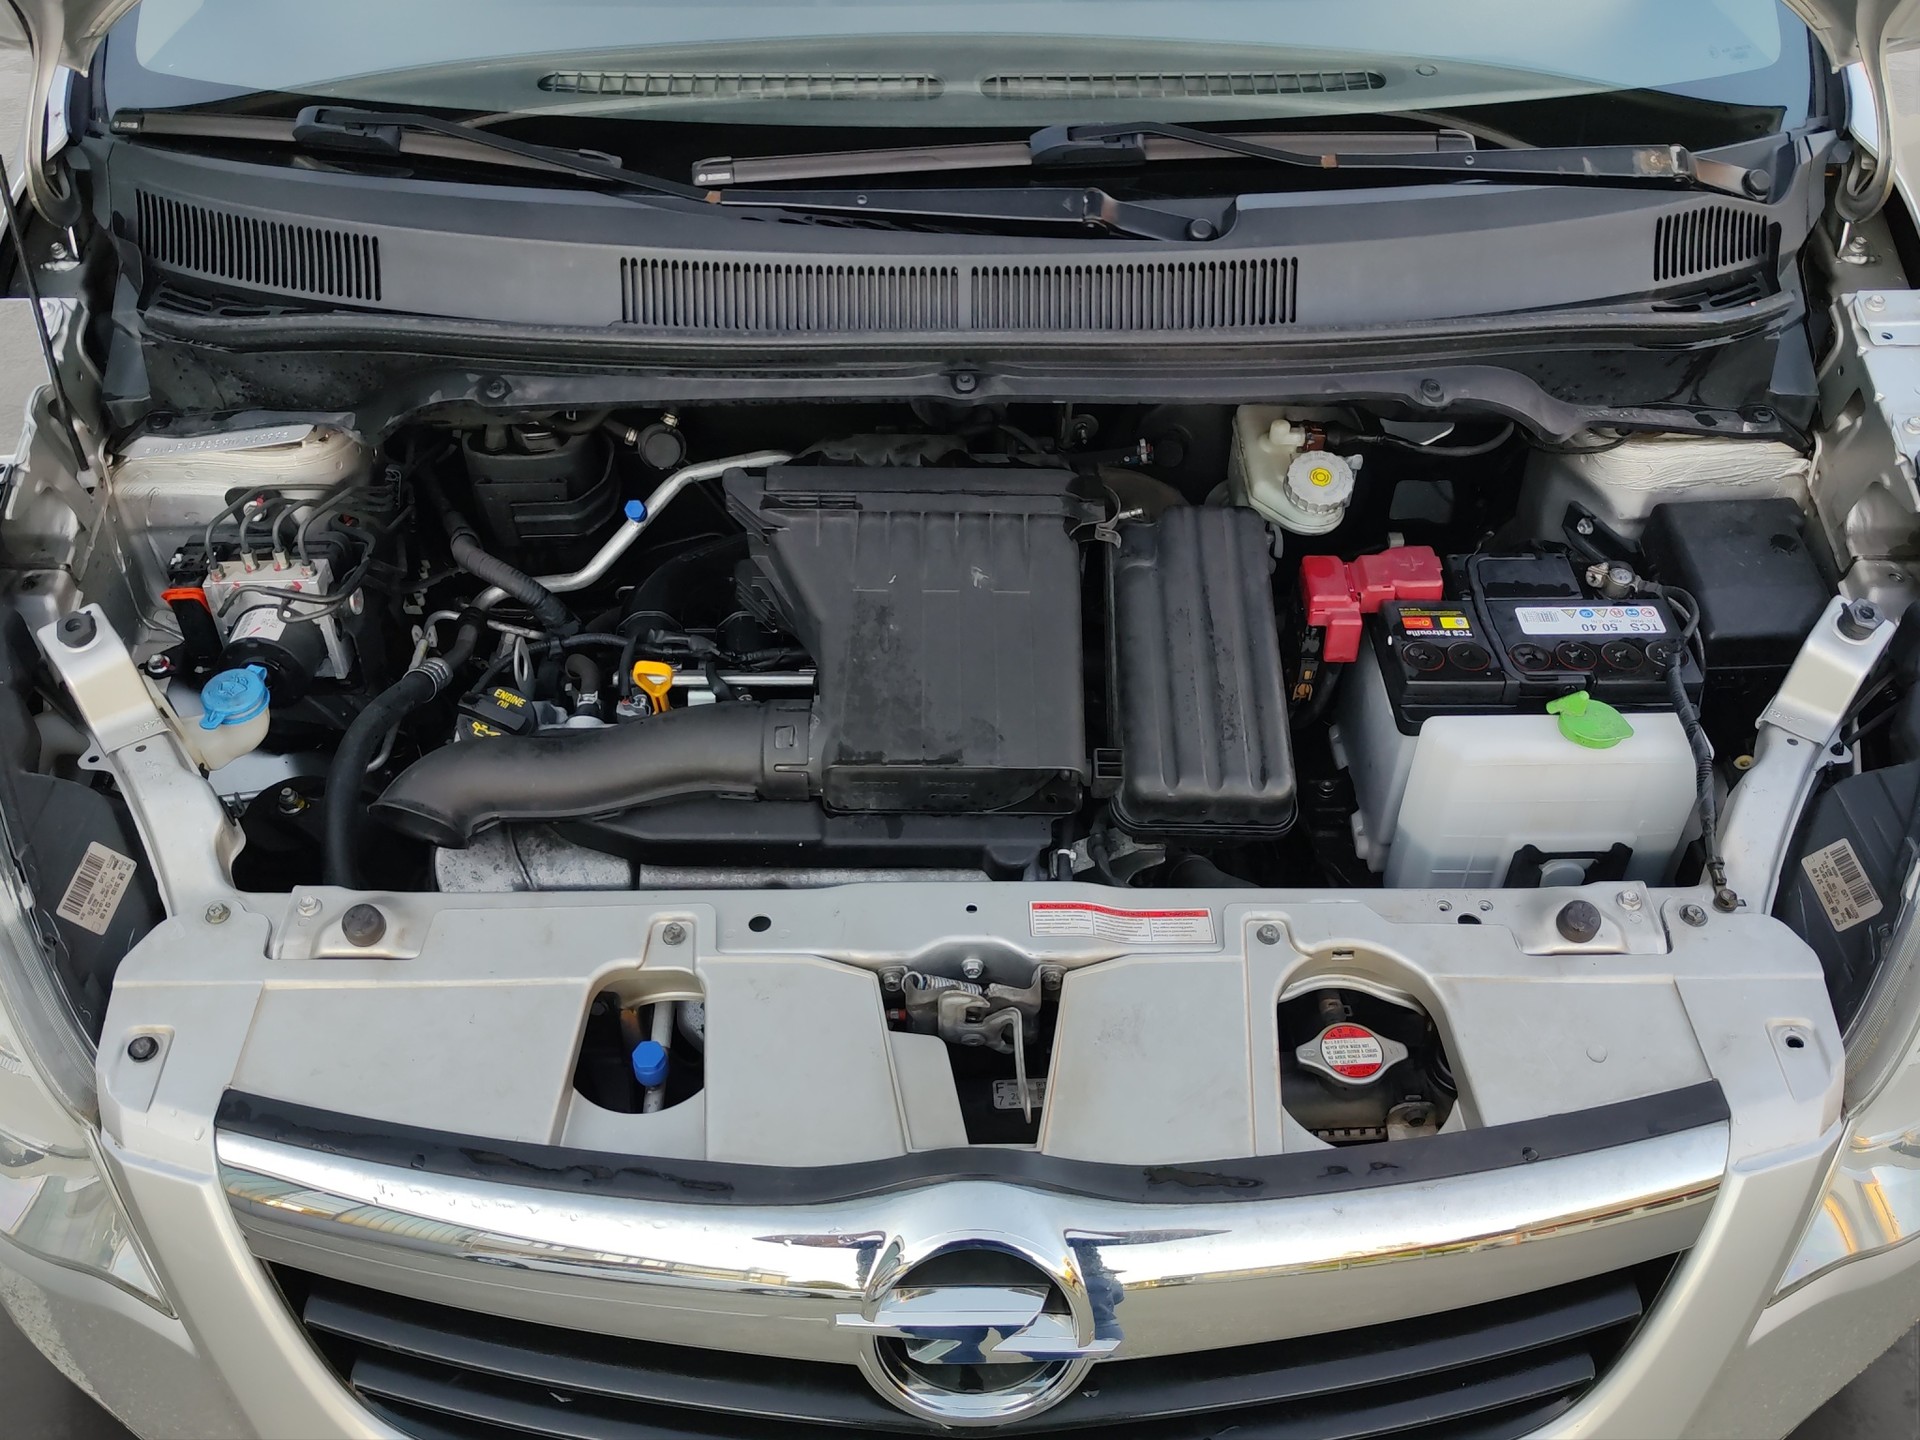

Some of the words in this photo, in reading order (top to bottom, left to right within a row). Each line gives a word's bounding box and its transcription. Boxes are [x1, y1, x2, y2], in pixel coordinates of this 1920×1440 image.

[1581, 623, 1597, 632] 40
[1602, 623, 1618, 632] 50
[1629, 623, 1661, 632] TCS
[1406, 629, 1452, 637] Patrouille
[1453, 629, 1473, 637] TCS
[493, 688, 527, 708] ENGINE
[996, 1082, 1005, 1094] F
[997, 1095, 1005, 1106] 7
